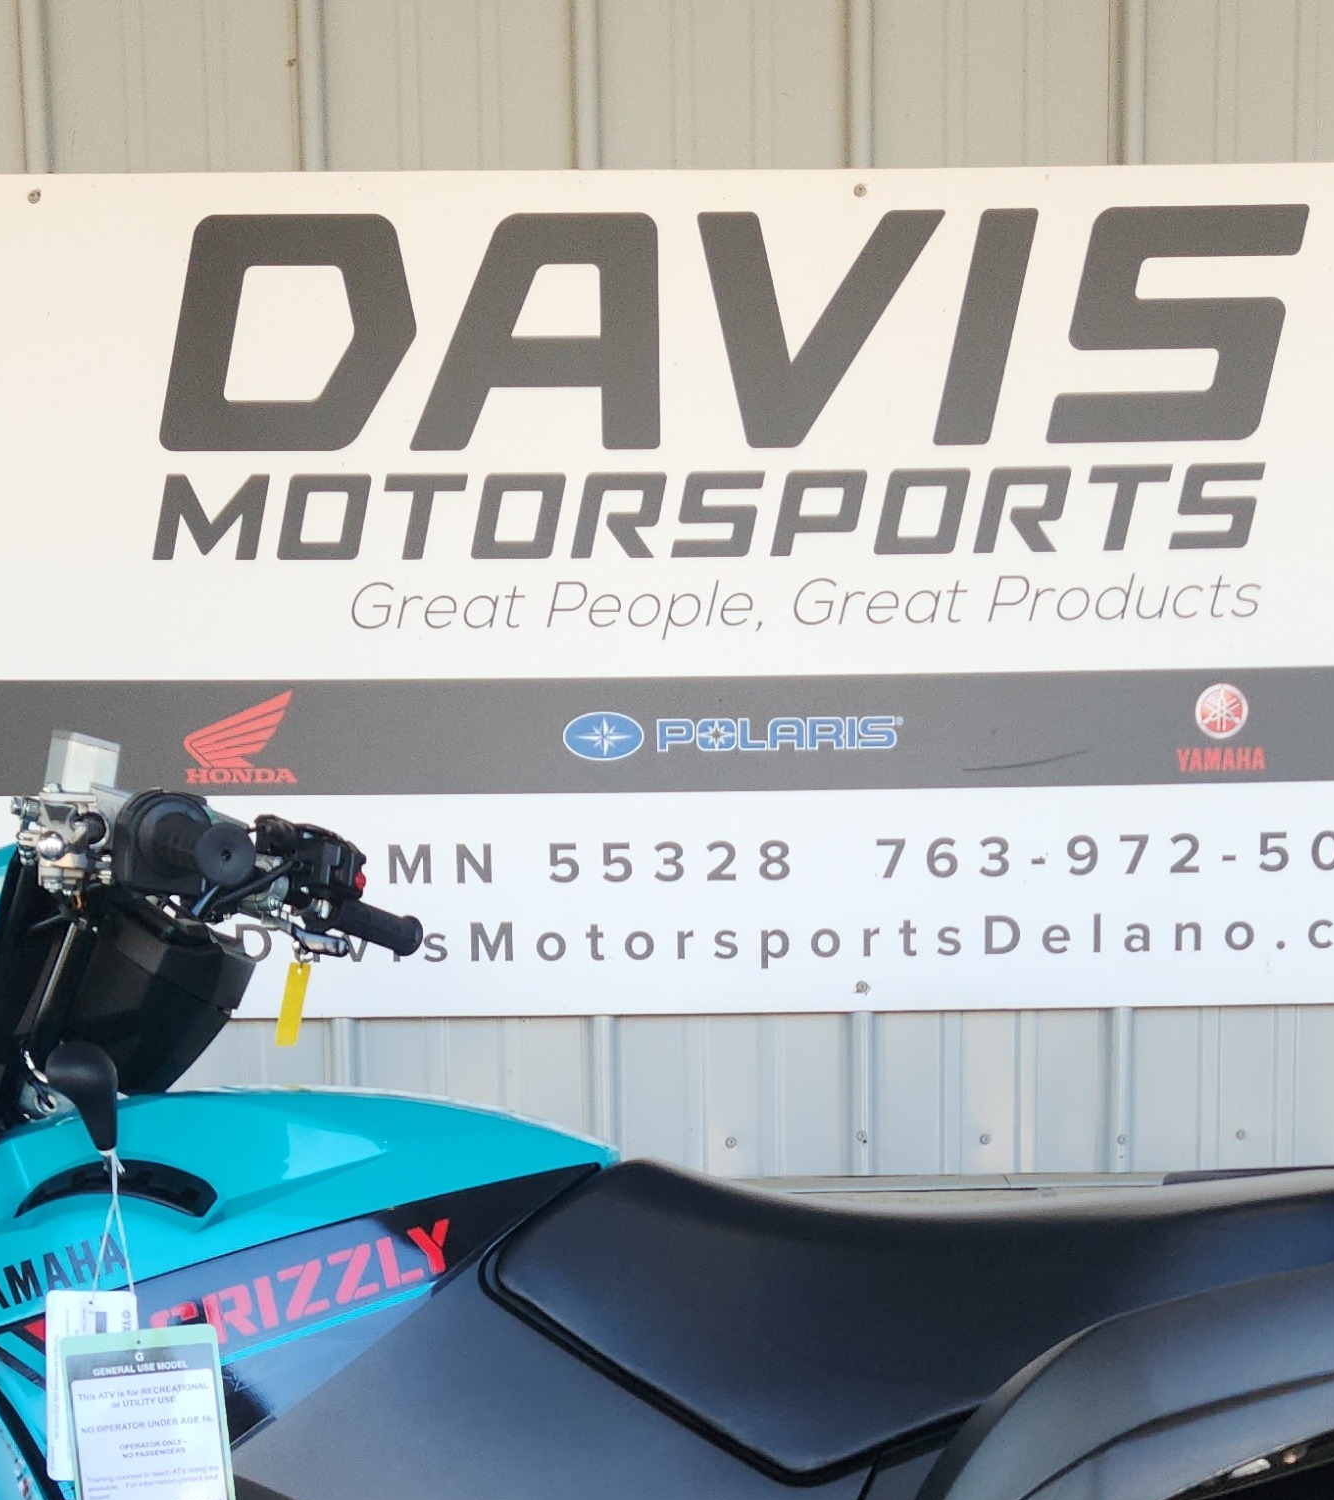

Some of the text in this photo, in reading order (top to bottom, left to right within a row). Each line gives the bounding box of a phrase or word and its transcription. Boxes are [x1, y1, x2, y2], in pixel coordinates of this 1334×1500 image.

[159, 204, 1311, 452] DAVIS
[153, 463, 1267, 561] MOTORSPORTS
[351, 573, 1263, 642] Great People, Great Products
[656, 715, 898, 753] POLARIS
[1175, 745, 1267, 774] YAMAHA
[185, 767, 299, 785] HONDA
[389, 844, 494, 886] MN
[550, 840, 792, 886] 55328
[134, 1351, 145, 1362] G
[92, 1360, 188, 1377] GENERAL USE MODEL
[98, 1390, 115, 1400] ATV
[126, 1388, 139, 1397] for
[140, 1382, 209, 1395] RECREATIONAL
[122, 1396, 156, 1408] UTILITY
[81, 1425, 95, 1434] NO
[97, 1420, 146, 1433] OPERATOR
[147, 1417, 179, 1429] UNDER
[180, 1415, 199, 1425] AGE
[119, 1439, 161, 1451] OPERATOR
[122, 1446, 186, 1460] NO PASSENGERS
